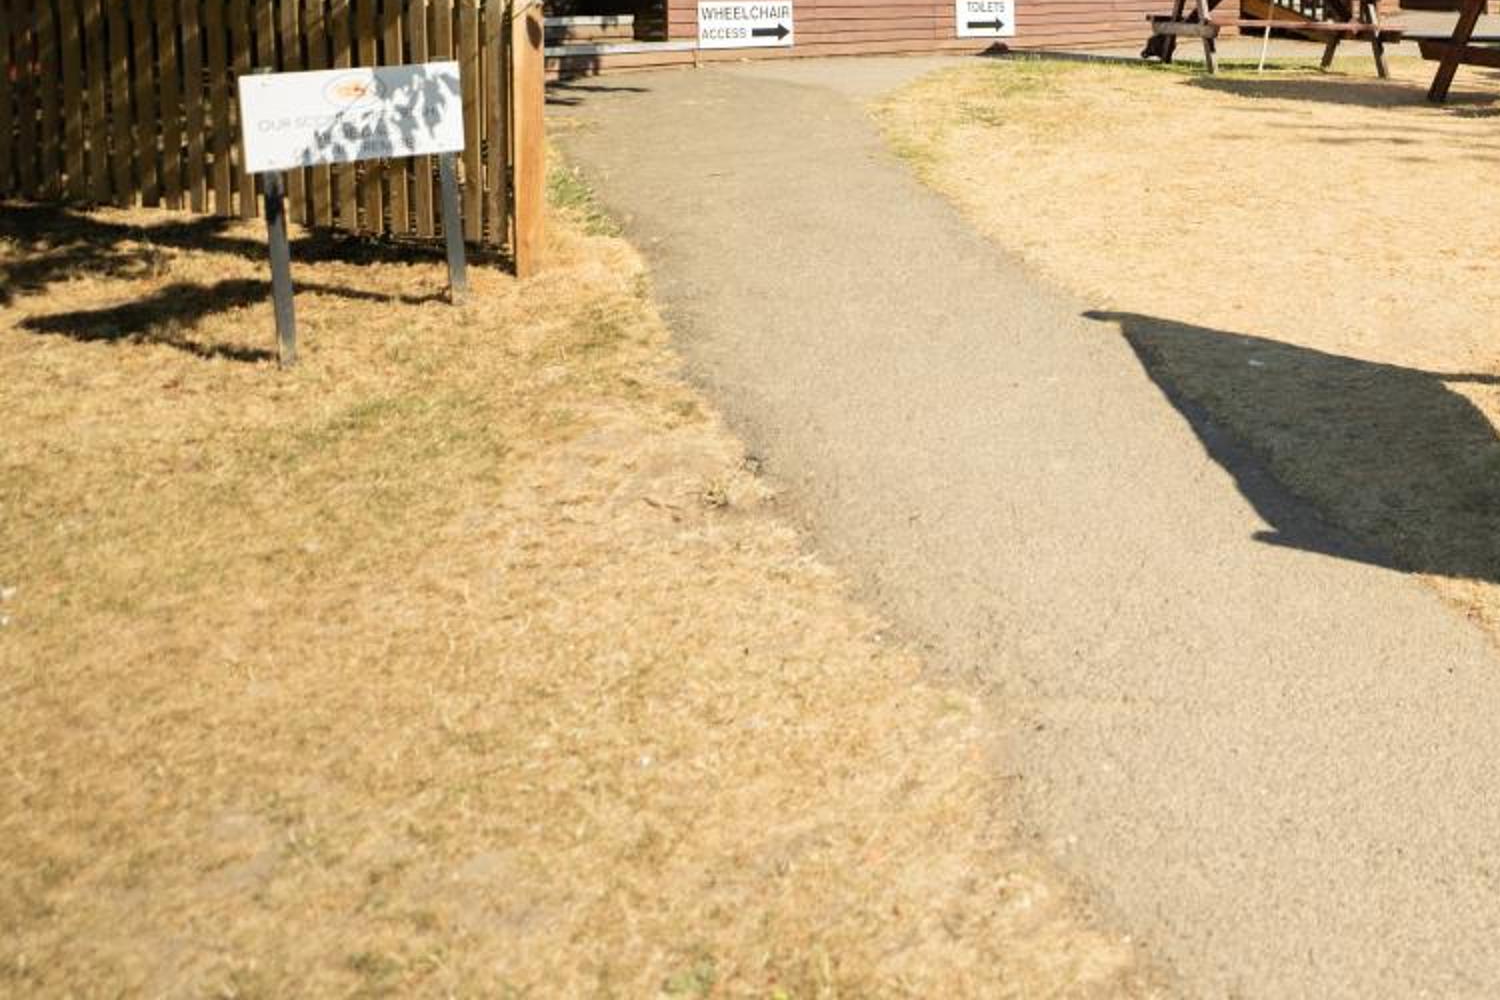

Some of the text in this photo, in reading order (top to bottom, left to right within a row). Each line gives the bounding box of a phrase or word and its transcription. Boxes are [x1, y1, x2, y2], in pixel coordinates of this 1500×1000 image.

[701, 6, 789, 20] WHEELCHAIR
[966, 1, 1005, 13] TOILETS
[702, 28, 747, 40] ACCESS
